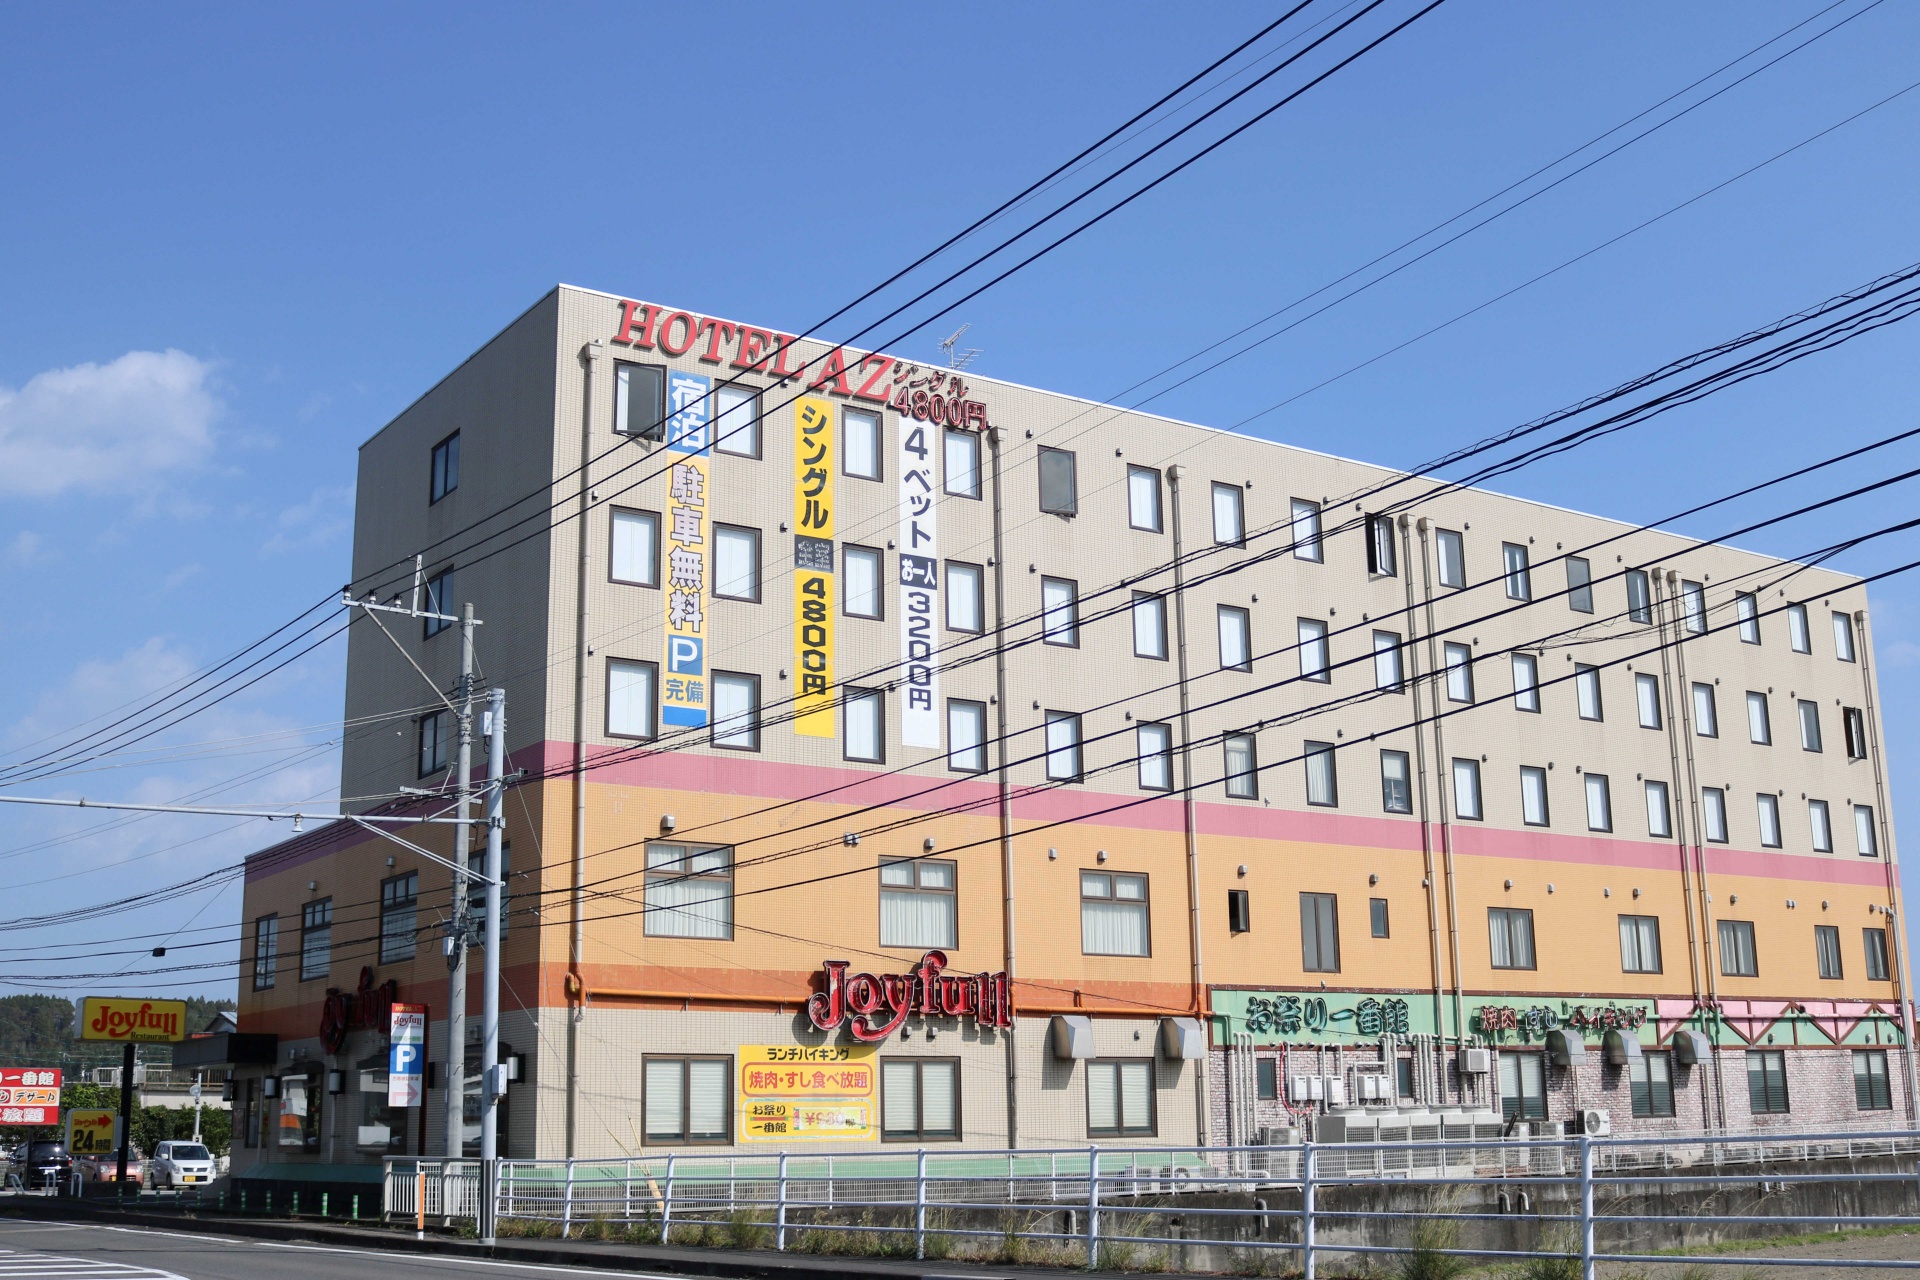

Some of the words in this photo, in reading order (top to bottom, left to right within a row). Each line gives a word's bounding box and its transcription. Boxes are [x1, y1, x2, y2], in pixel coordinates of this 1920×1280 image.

[613, 299, 805, 379] HOTEL
[809, 346, 897, 402] AZ
[893, 361, 969, 399] シングル
[672, 378, 707, 449] 宿泊
[894, 386, 987, 431] 4800円
[801, 405, 829, 530] シングル
[668, 462, 704, 634] 駐車無料
[901, 557, 937, 586] お一人
[802, 577, 826, 696] 4800円
[672, 637, 698, 672] P
[908, 591, 932, 712] 3200円
[665, 678, 704, 704] 完備
[808, 949, 1013, 1043] Joyfull
[91, 1002, 178, 1039] Joyfull
[393, 1014, 422, 1027] Joyfull
[1245, 995, 1410, 1035] お祭り一番館
[1481, 1004, 1518, 1032] 焼肉
[130, 1031, 170, 1041] Restaurant
[396, 1044, 417, 1072] P
[767, 1048, 850, 1061] ランチバイキング
[0, 1071, 55, 1086] 一番館
[749, 1070, 868, 1089] 焼肉・すし食べ放題
[15, 1091, 55, 1103] デザート
[752, 1105, 786, 1116] お祭り
[0, 1108, 45, 1123] 放題
[752, 1122, 787, 1133] 一番館
[73, 1129, 94, 1152] 24
